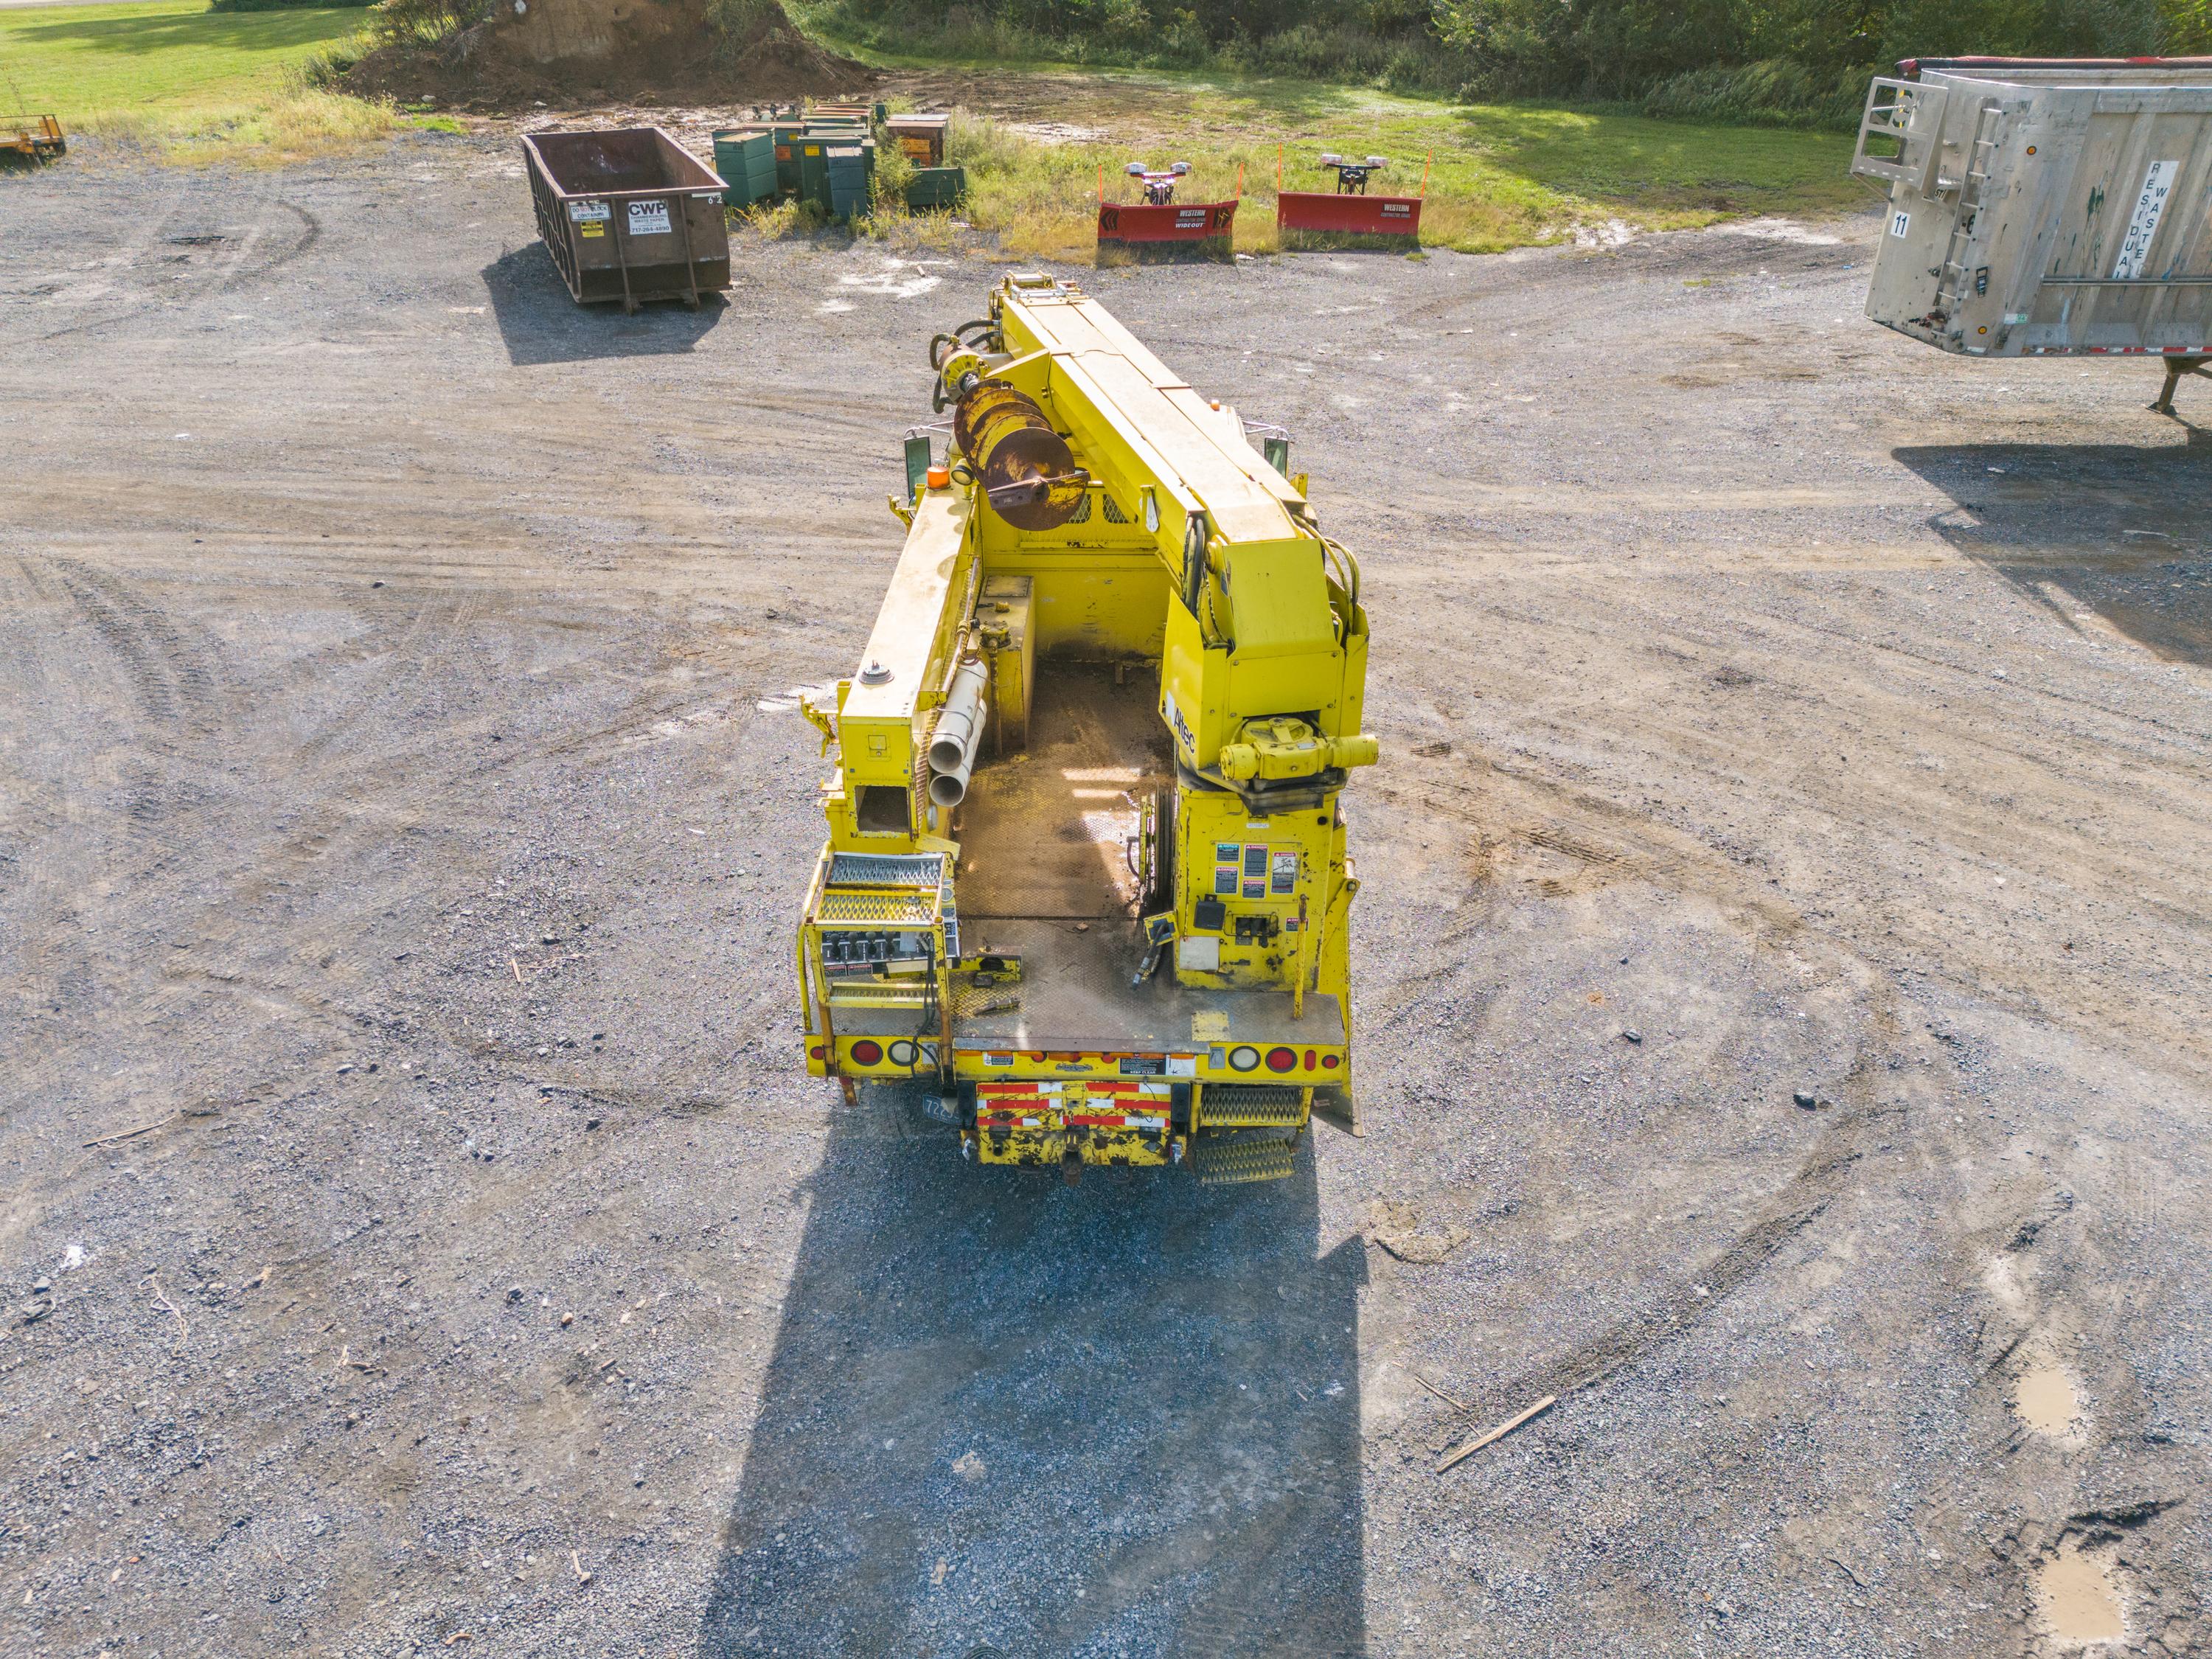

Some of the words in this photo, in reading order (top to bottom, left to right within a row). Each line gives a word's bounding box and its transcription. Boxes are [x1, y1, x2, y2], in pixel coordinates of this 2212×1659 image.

[629, 203, 666, 215] CWP
[1180, 209, 1206, 218] WESTERN
[1384, 204, 1410, 212] WESTERN
[1896, 214, 1907, 236] 11
[2135, 187, 2168, 259] WASTE
[1174, 706, 1195, 754] Altec
